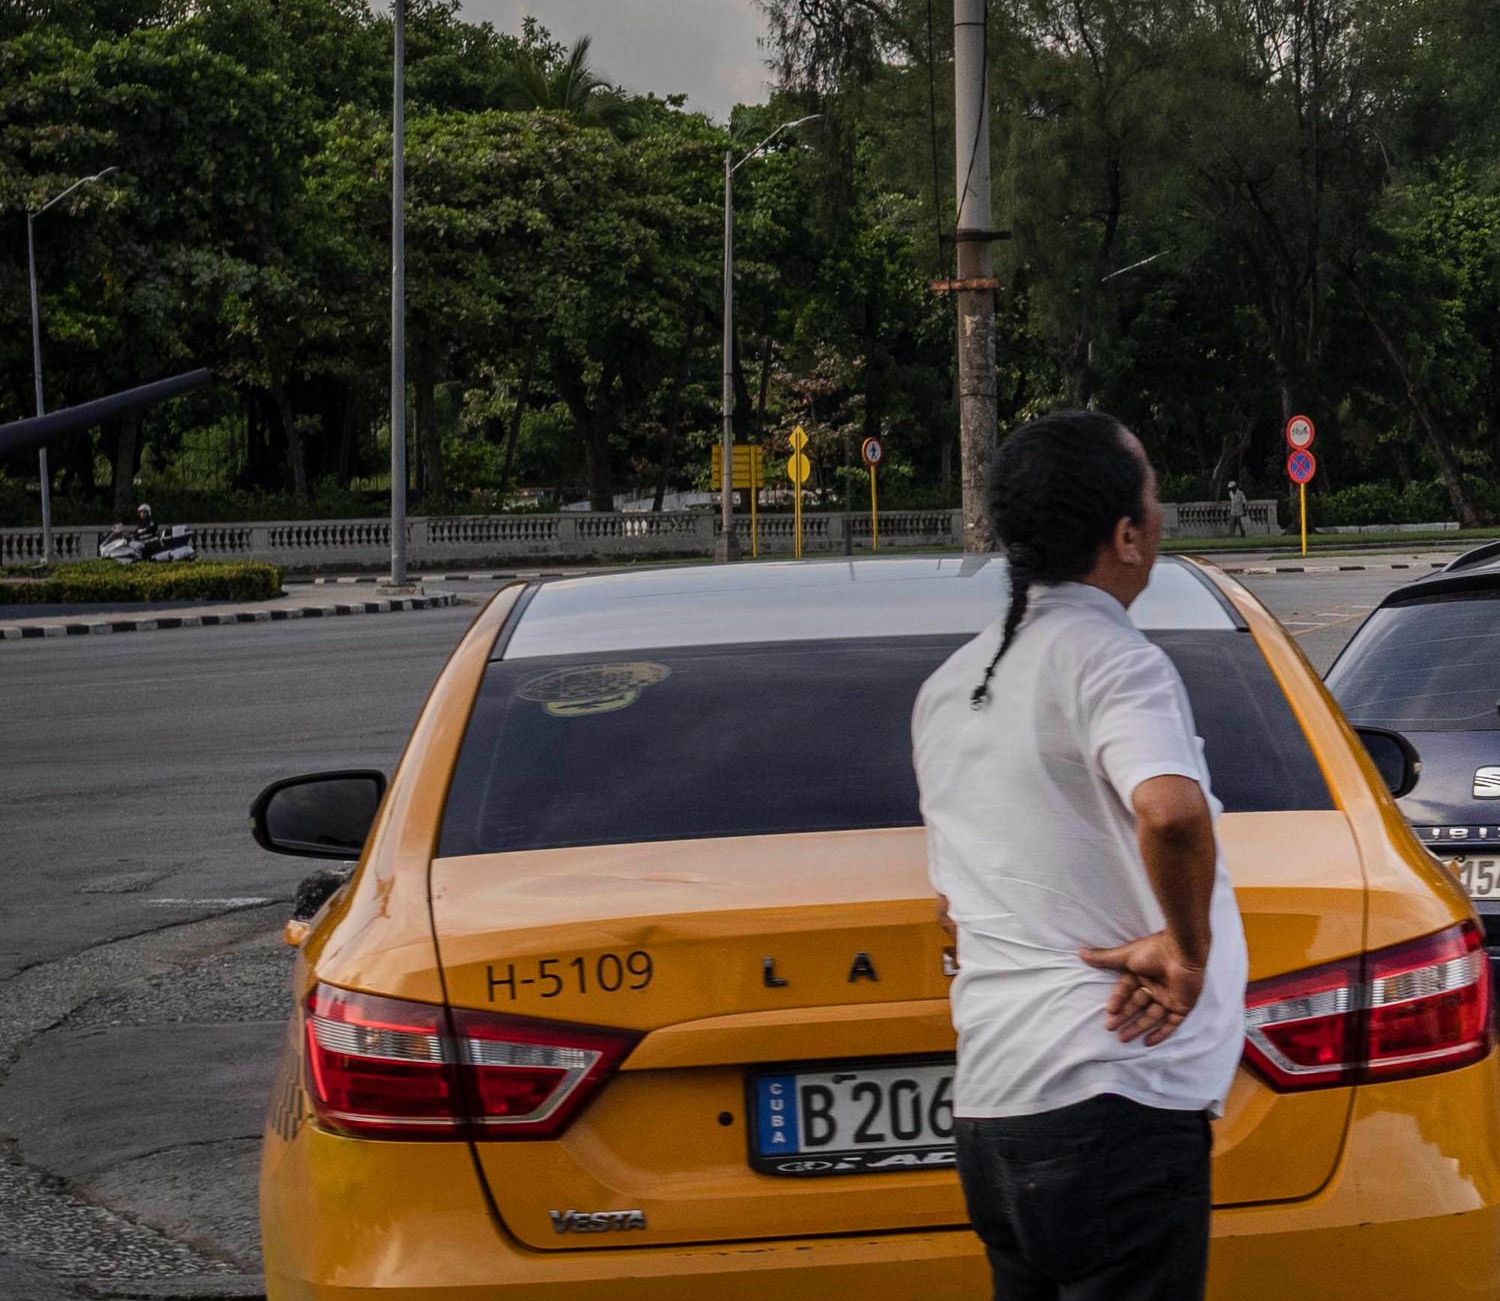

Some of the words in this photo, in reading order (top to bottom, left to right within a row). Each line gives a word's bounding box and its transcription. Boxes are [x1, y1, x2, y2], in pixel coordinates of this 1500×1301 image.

[486, 950, 654, 1002] H-5109
[769, 1082, 787, 1144] CUBA
[800, 1084, 837, 1147] B
[549, 1208, 646, 1233] VESTA
